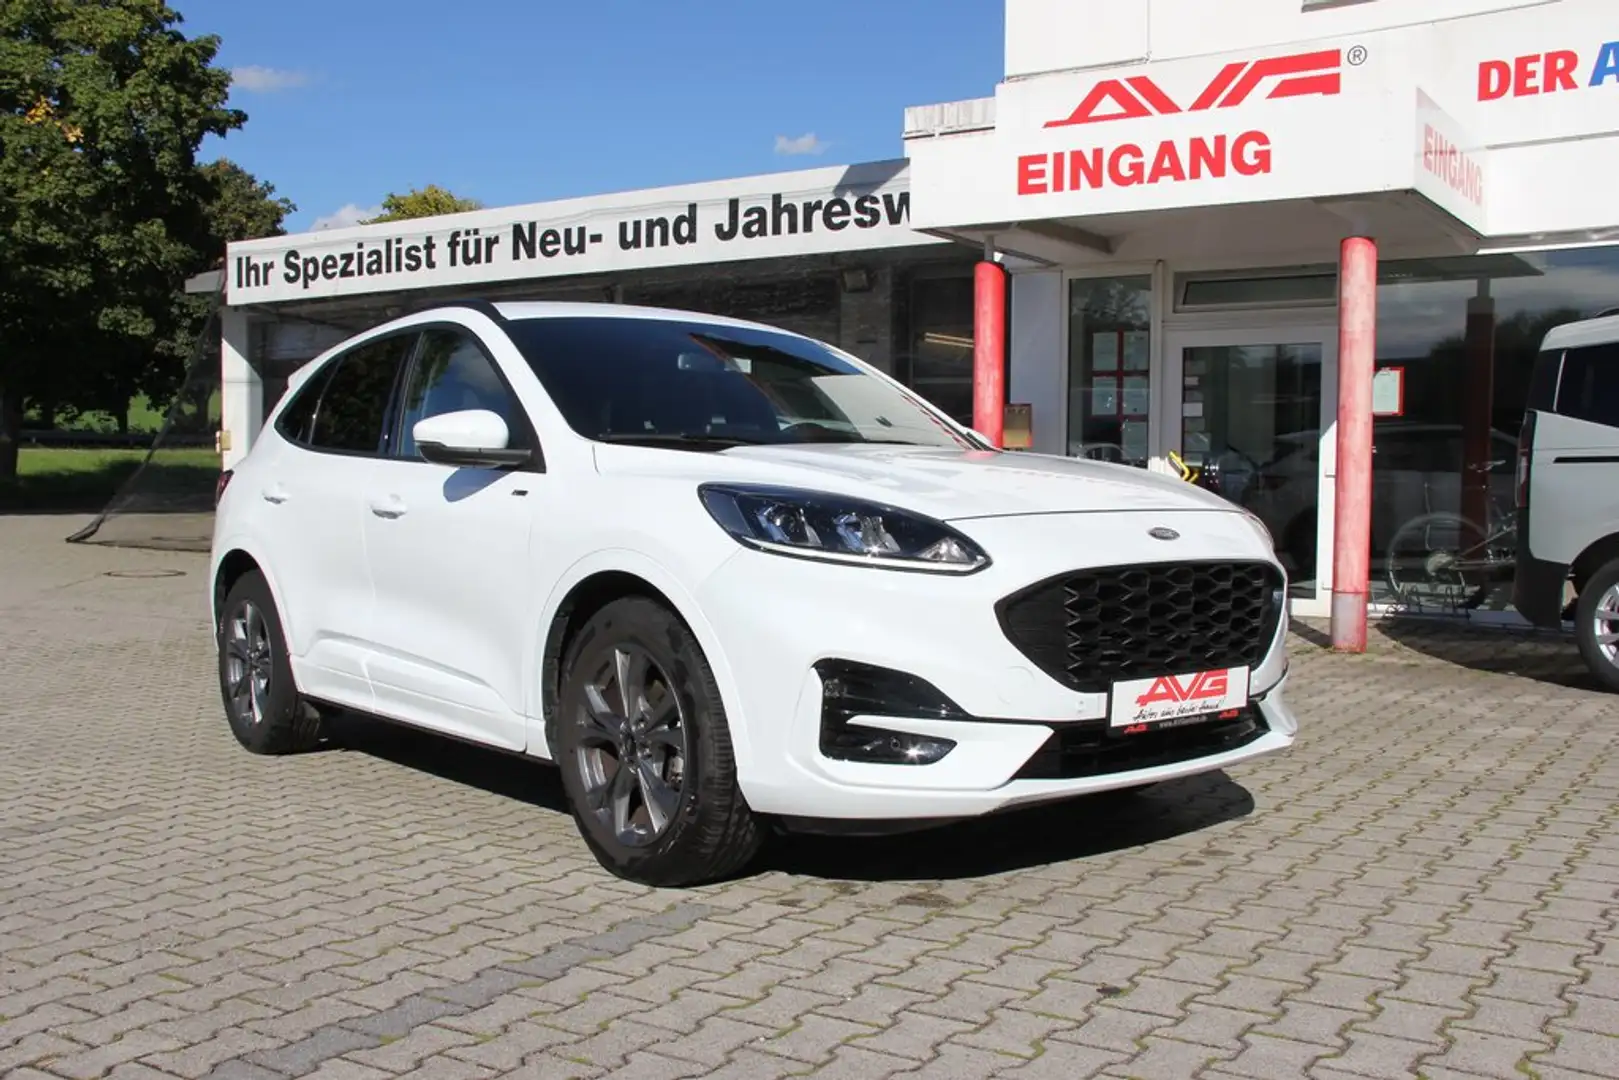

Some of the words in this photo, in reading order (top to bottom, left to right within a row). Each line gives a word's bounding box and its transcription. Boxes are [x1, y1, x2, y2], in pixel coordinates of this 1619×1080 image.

[1477, 49, 1579, 102] DER
[1018, 130, 1272, 195] EINGANG
[1423, 123, 1482, 205] EINGANG
[236, 255, 274, 288] Ihr
[283, 235, 436, 289] Spezialist
[447, 228, 499, 267] für
[512, 221, 603, 260] Neu-
[619, 203, 697, 250] und
[1135, 668, 1228, 706] AVG
